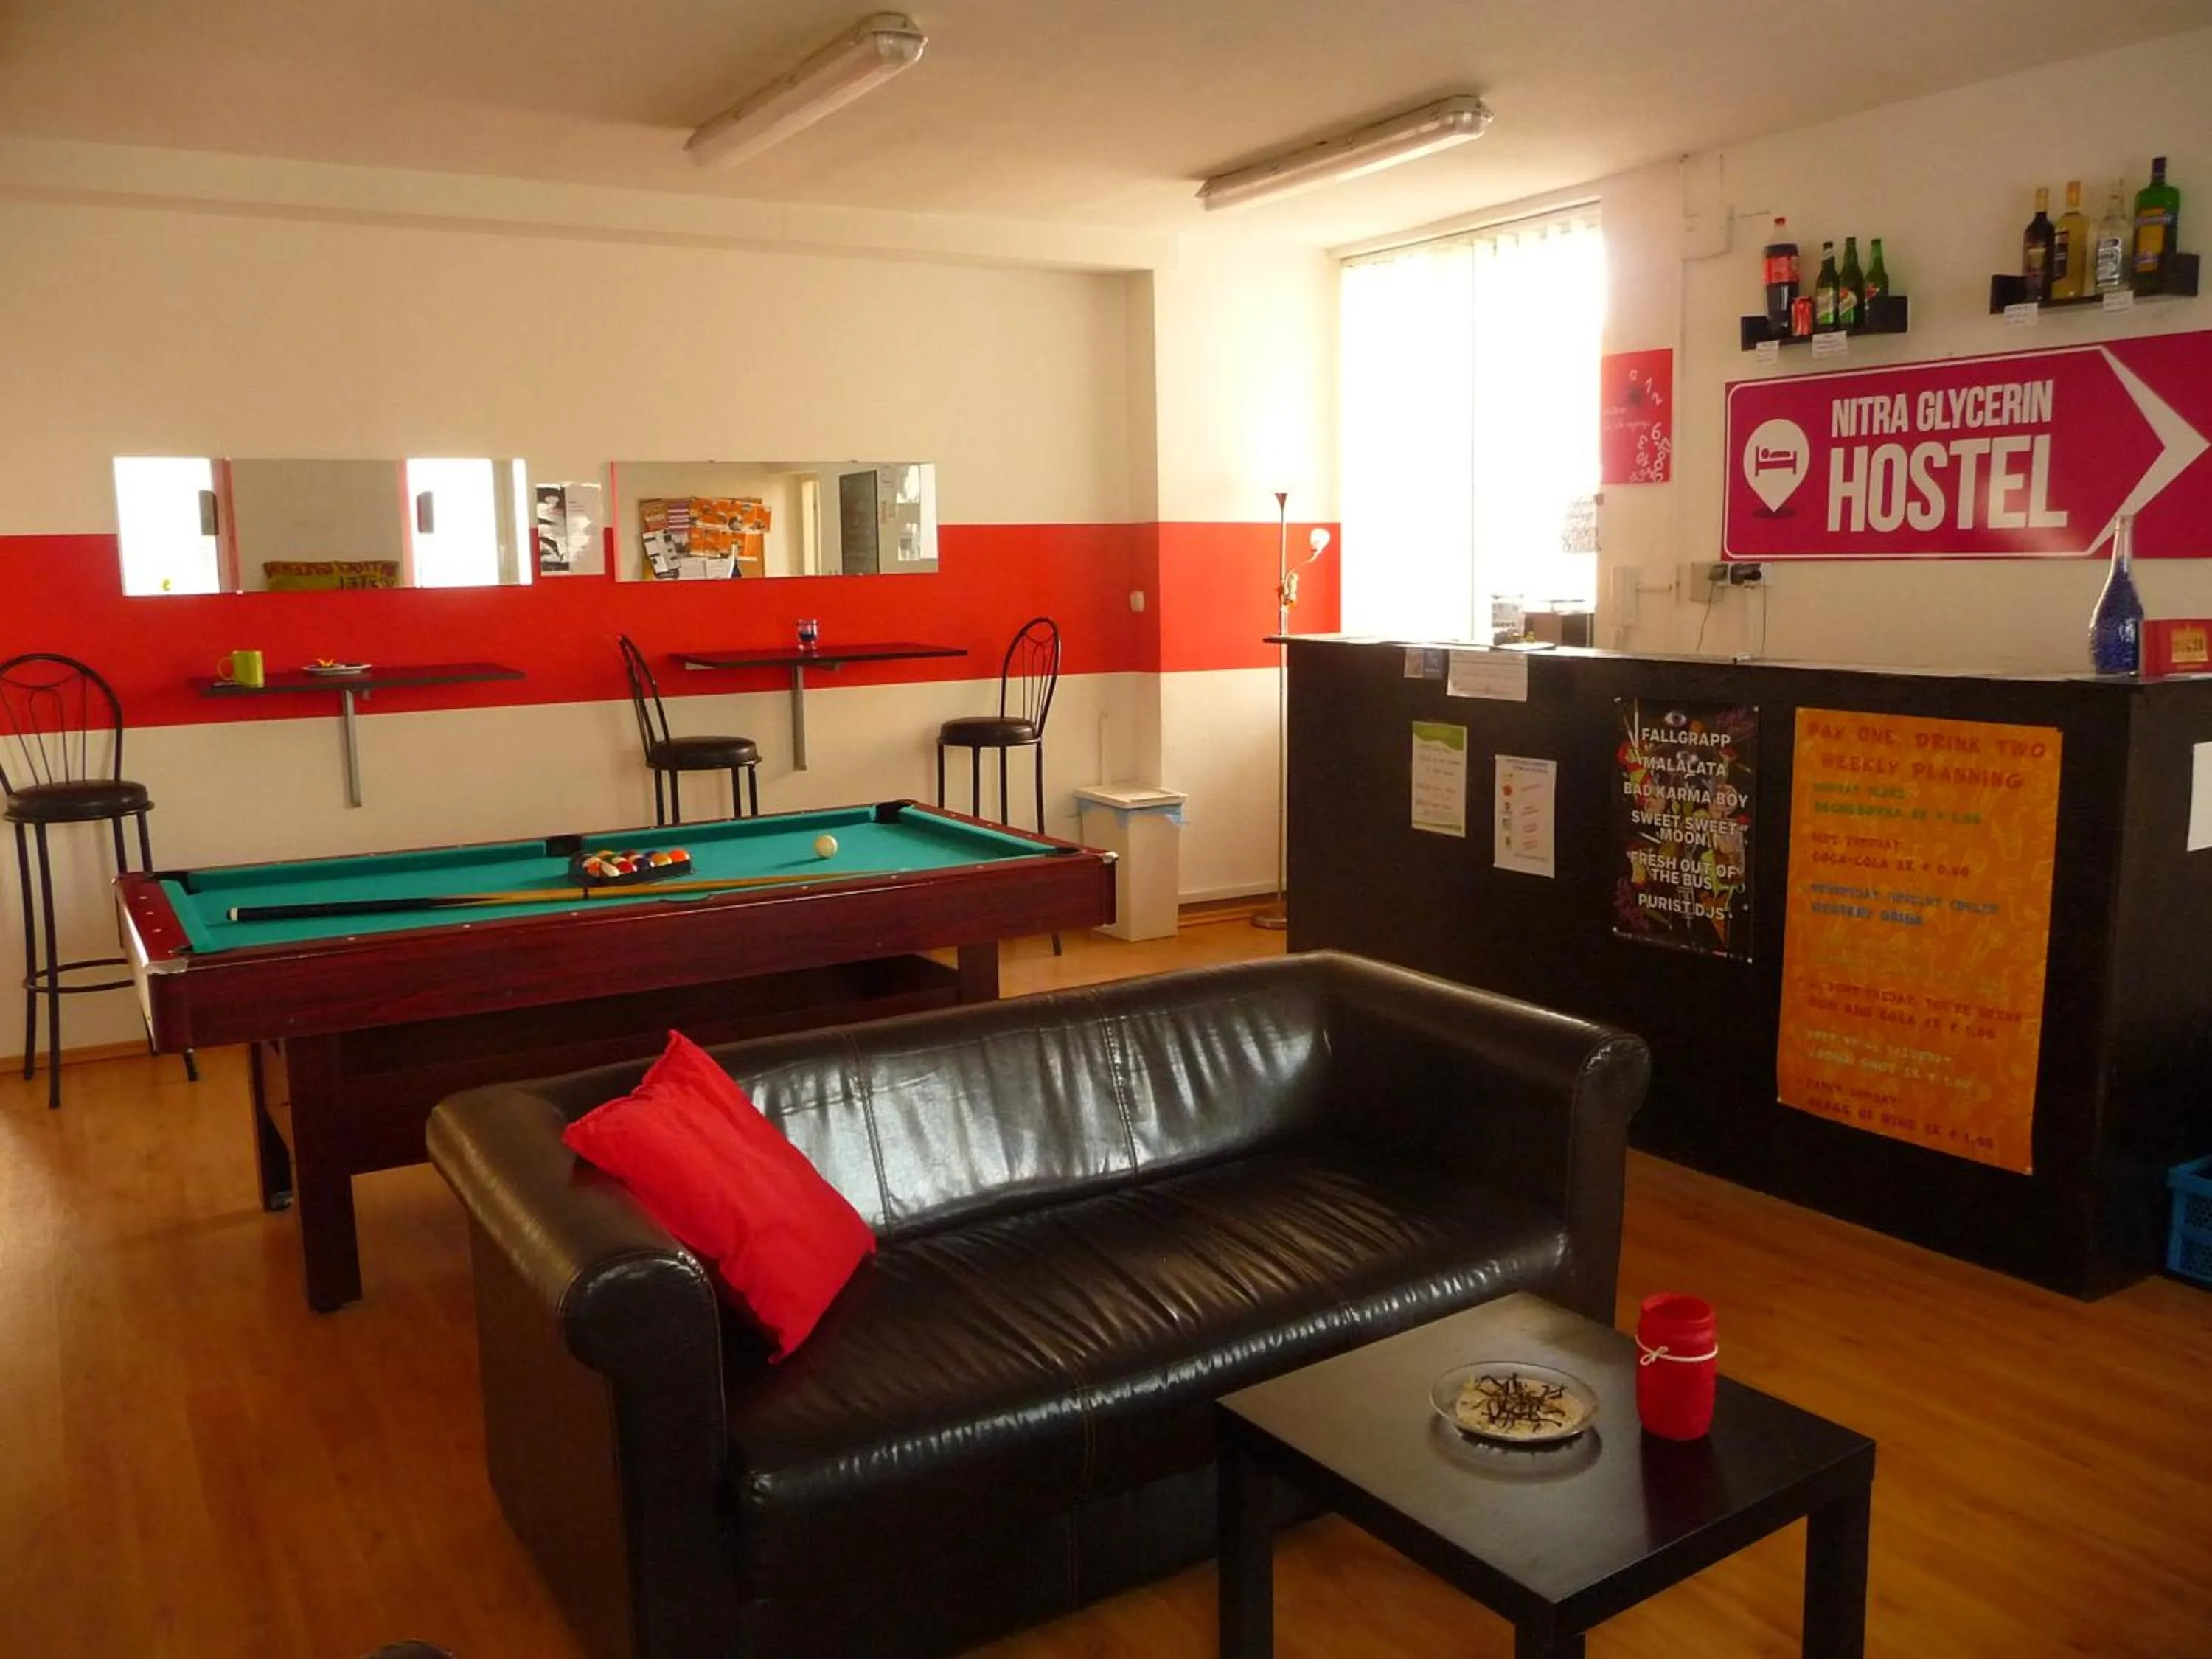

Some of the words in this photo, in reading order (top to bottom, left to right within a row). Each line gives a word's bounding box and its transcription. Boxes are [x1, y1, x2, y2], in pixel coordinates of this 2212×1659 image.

[1831, 392, 1909, 437] NITRA
[1916, 380, 2053, 431] GLYCERIN
[1827, 435, 2067, 532] HOSTEL
[1641, 728, 1731, 747] FALLGRAPP
[1807, 722, 1846, 740] PAY
[1915, 732, 1980, 753] DRINK
[1995, 740, 2046, 759] TWO
[1643, 757, 1728, 776] MALALATA
[1820, 754, 1899, 774] WEEKLY
[1911, 762, 2023, 790] PLANNING
[1623, 783, 1651, 796] BAD
[1656, 787, 1711, 804] KARMA
[1715, 793, 1748, 808] BOY
[1631, 810, 1680, 827] SWEET
[1685, 818, 1737, 835] SWEET
[1658, 830, 1705, 846] MOON
[1631, 852, 1677, 870] FRESH
[1680, 858, 1711, 875] OUT
[1716, 864, 1737, 878] OF
[1651, 869, 1680, 884] THE
[1683, 874, 1713, 891] BUS
[1638, 893, 1691, 914] PURIST
